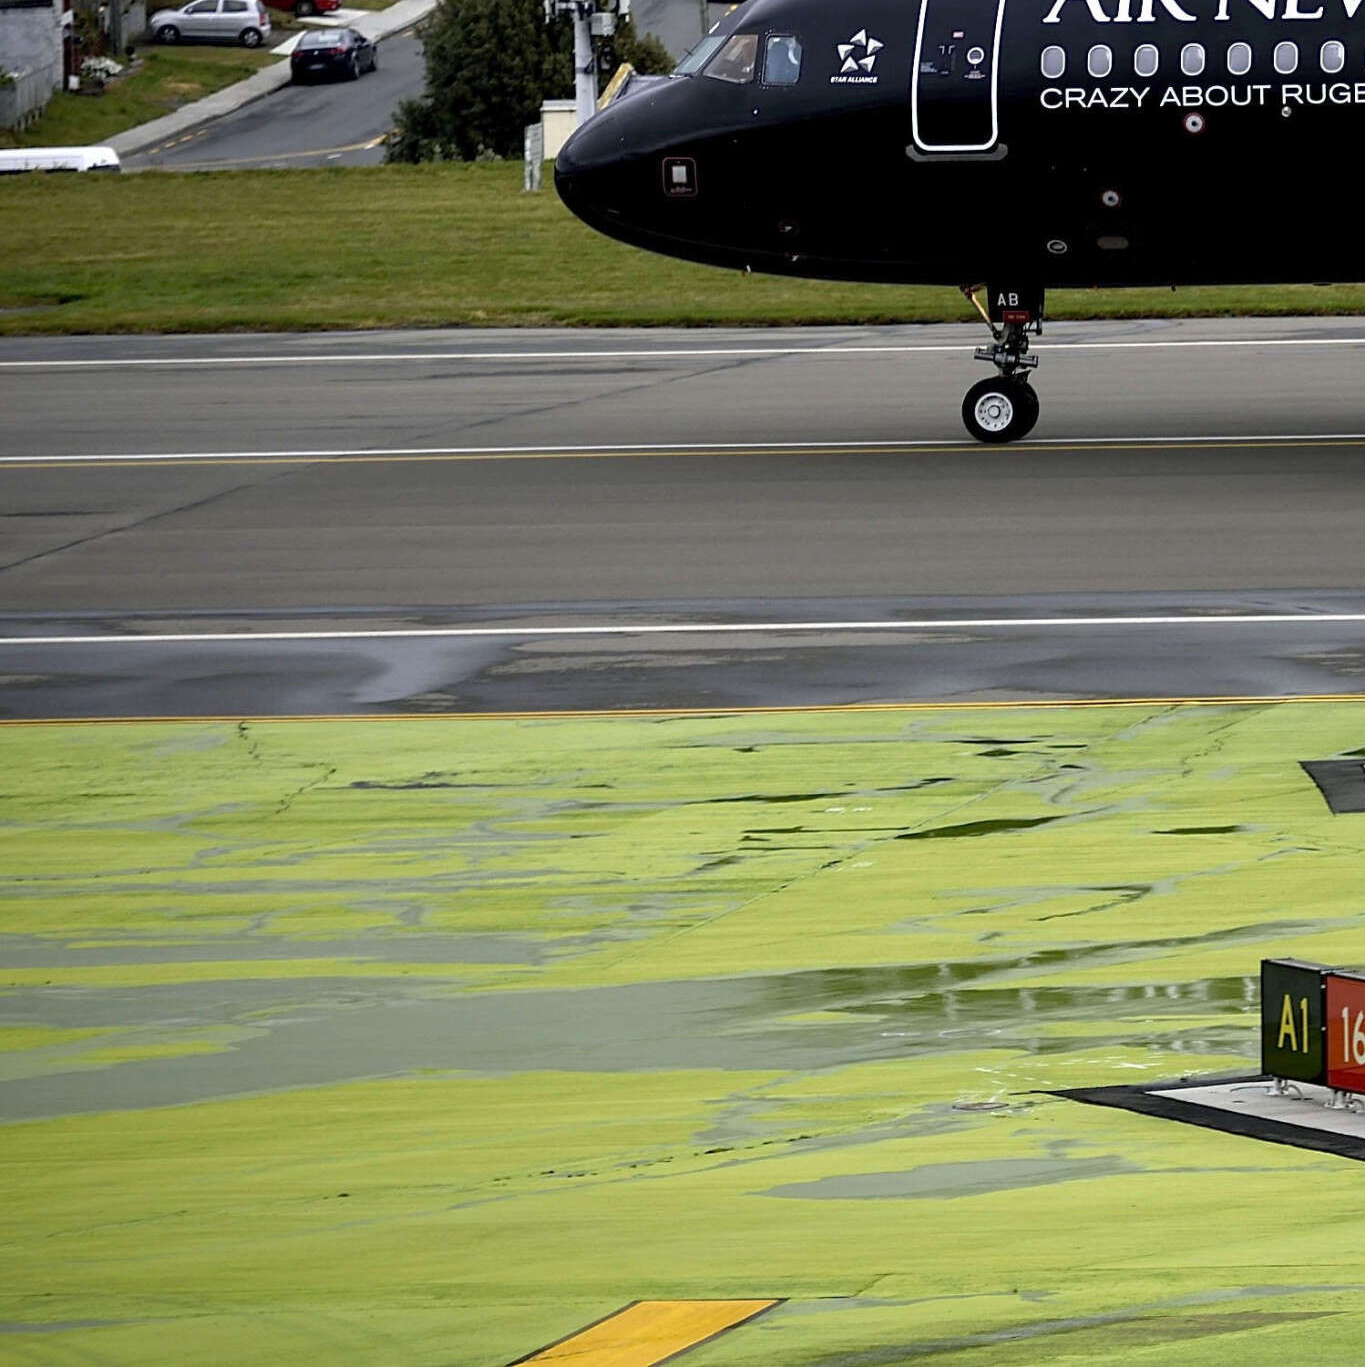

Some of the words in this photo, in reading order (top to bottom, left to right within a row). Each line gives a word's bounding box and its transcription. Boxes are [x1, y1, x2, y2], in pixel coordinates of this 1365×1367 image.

[1040, 86, 1151, 109] CRAZY
[1160, 84, 1271, 108] ABOUT
[997, 292, 1019, 307] AB
[1277, 994, 1309, 1054] A1
